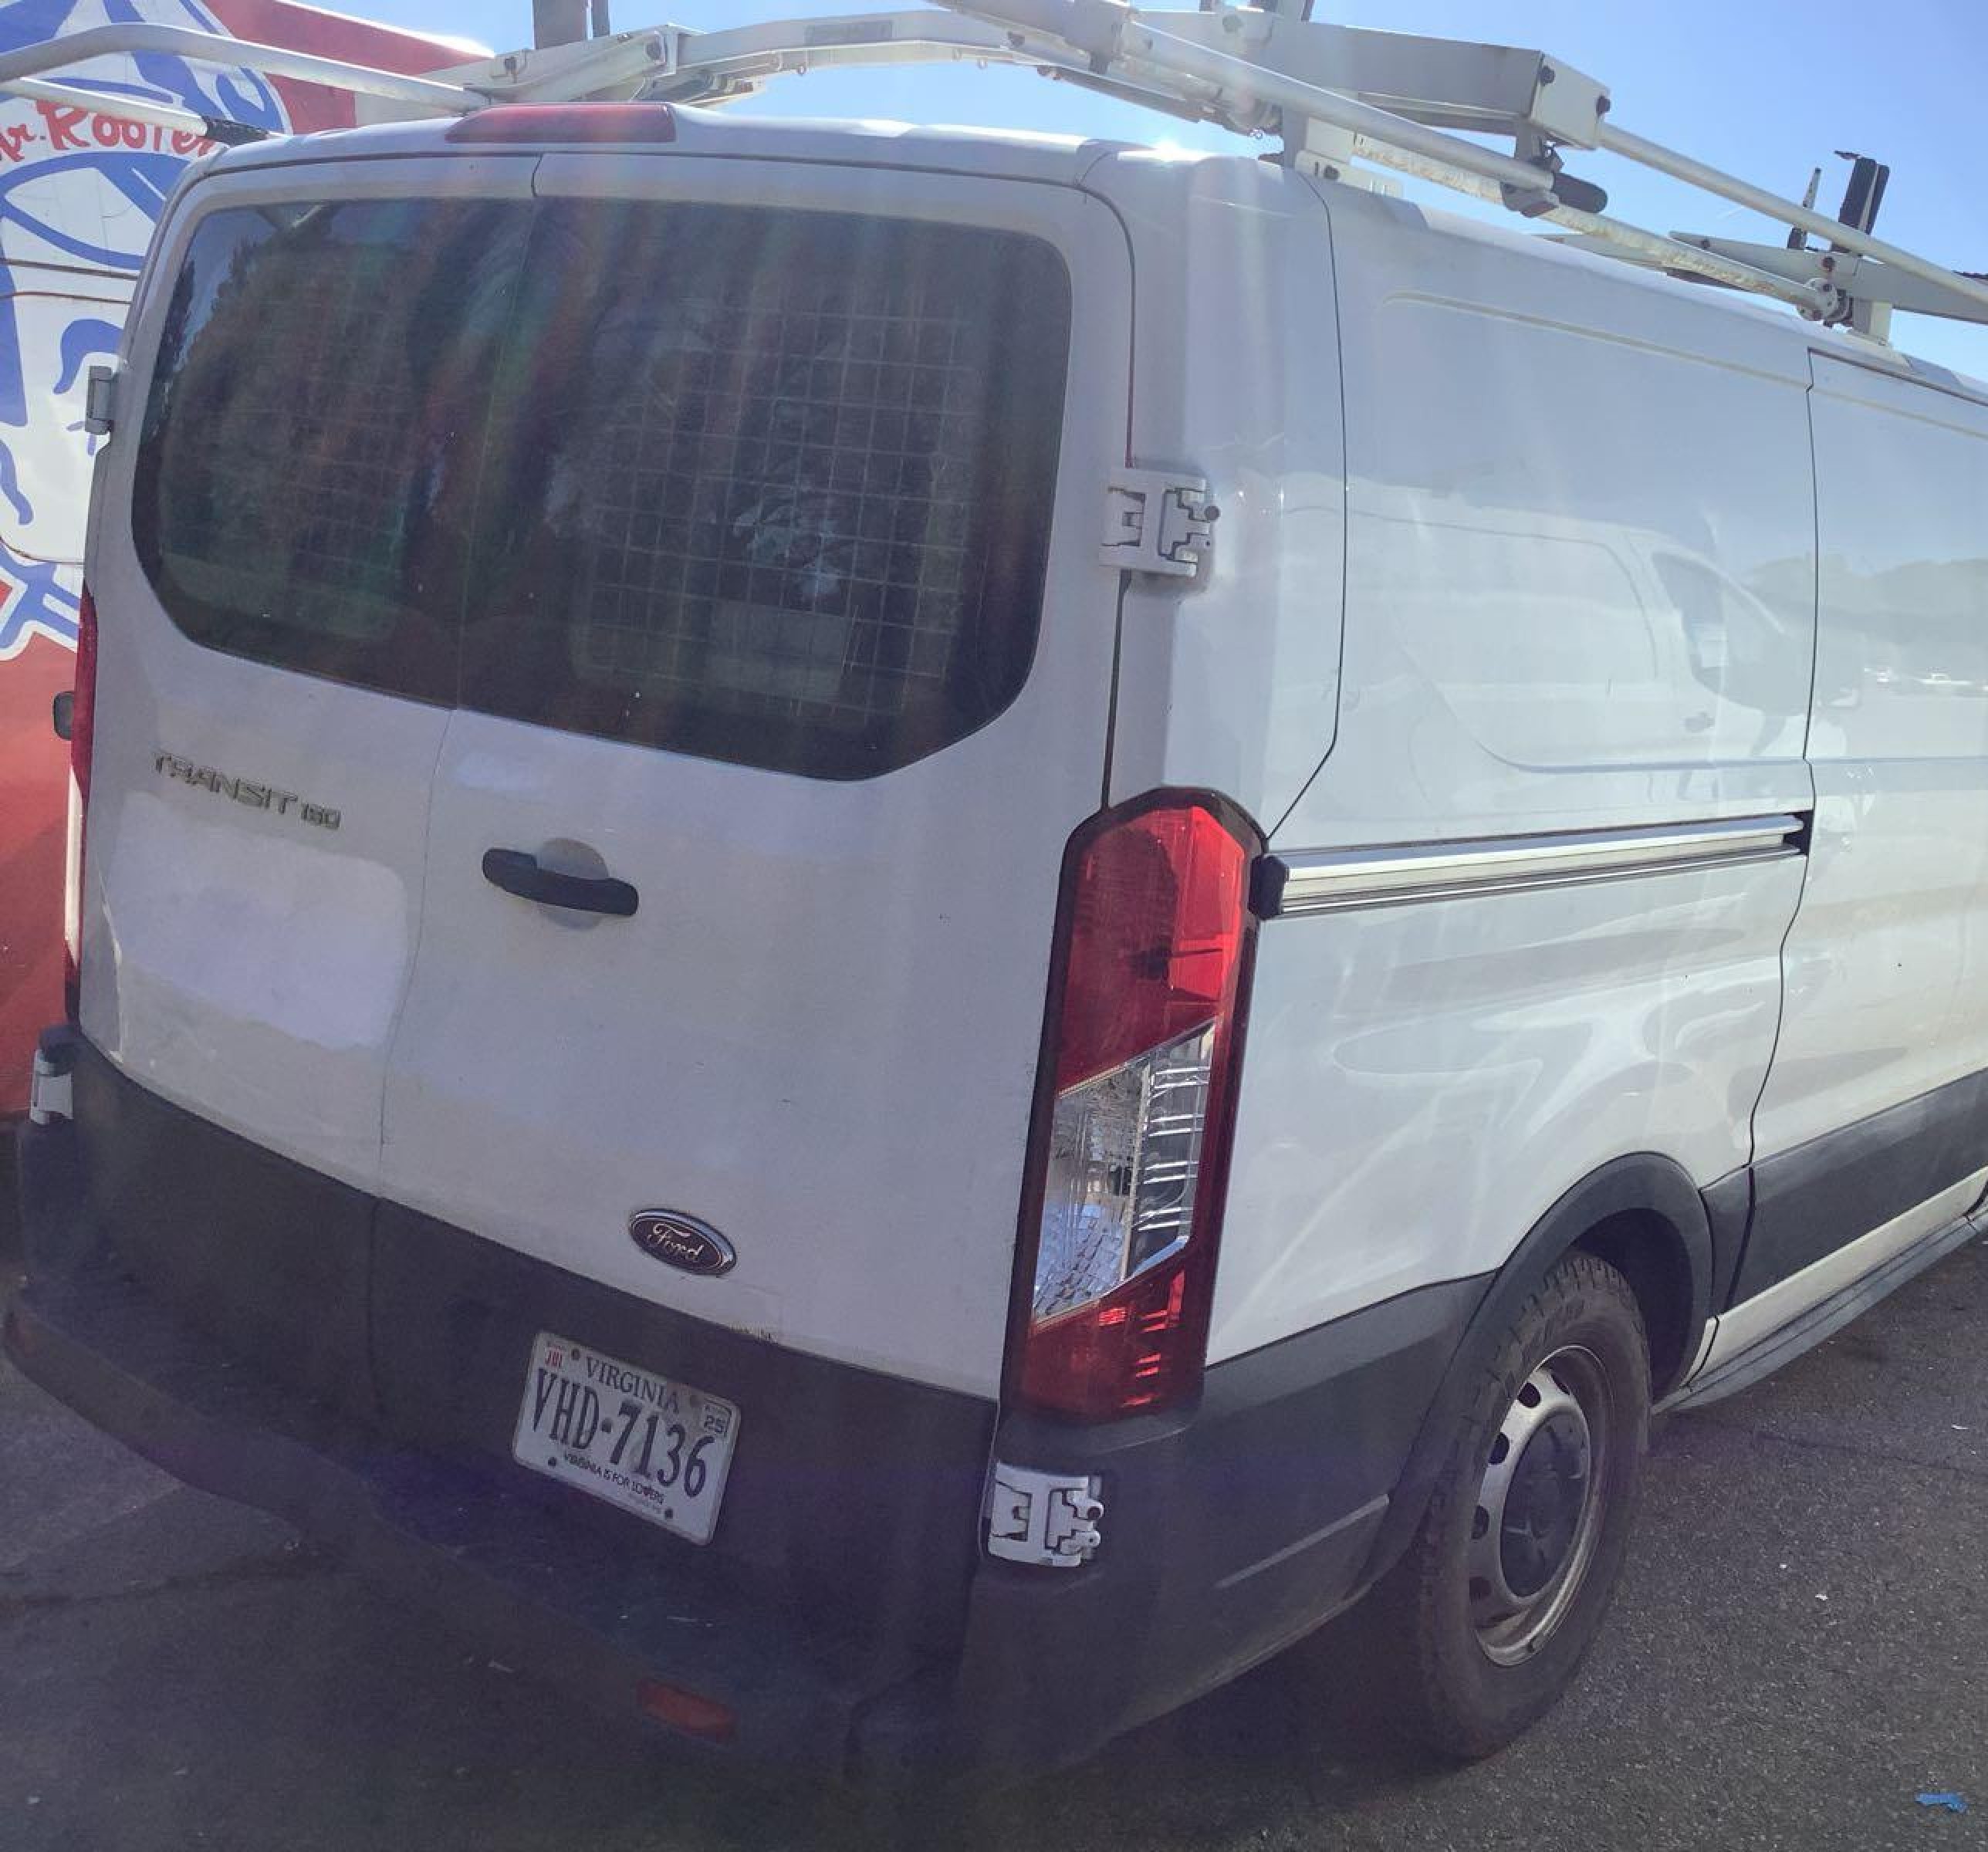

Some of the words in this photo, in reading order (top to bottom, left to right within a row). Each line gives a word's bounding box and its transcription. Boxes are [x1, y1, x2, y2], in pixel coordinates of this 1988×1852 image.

[154, 752, 299, 815] TRANSIT
[647, 1223, 705, 1261] Ford
[586, 1356, 680, 1414] VIRGINIA
[533, 1367, 715, 1498] VHD-7136
